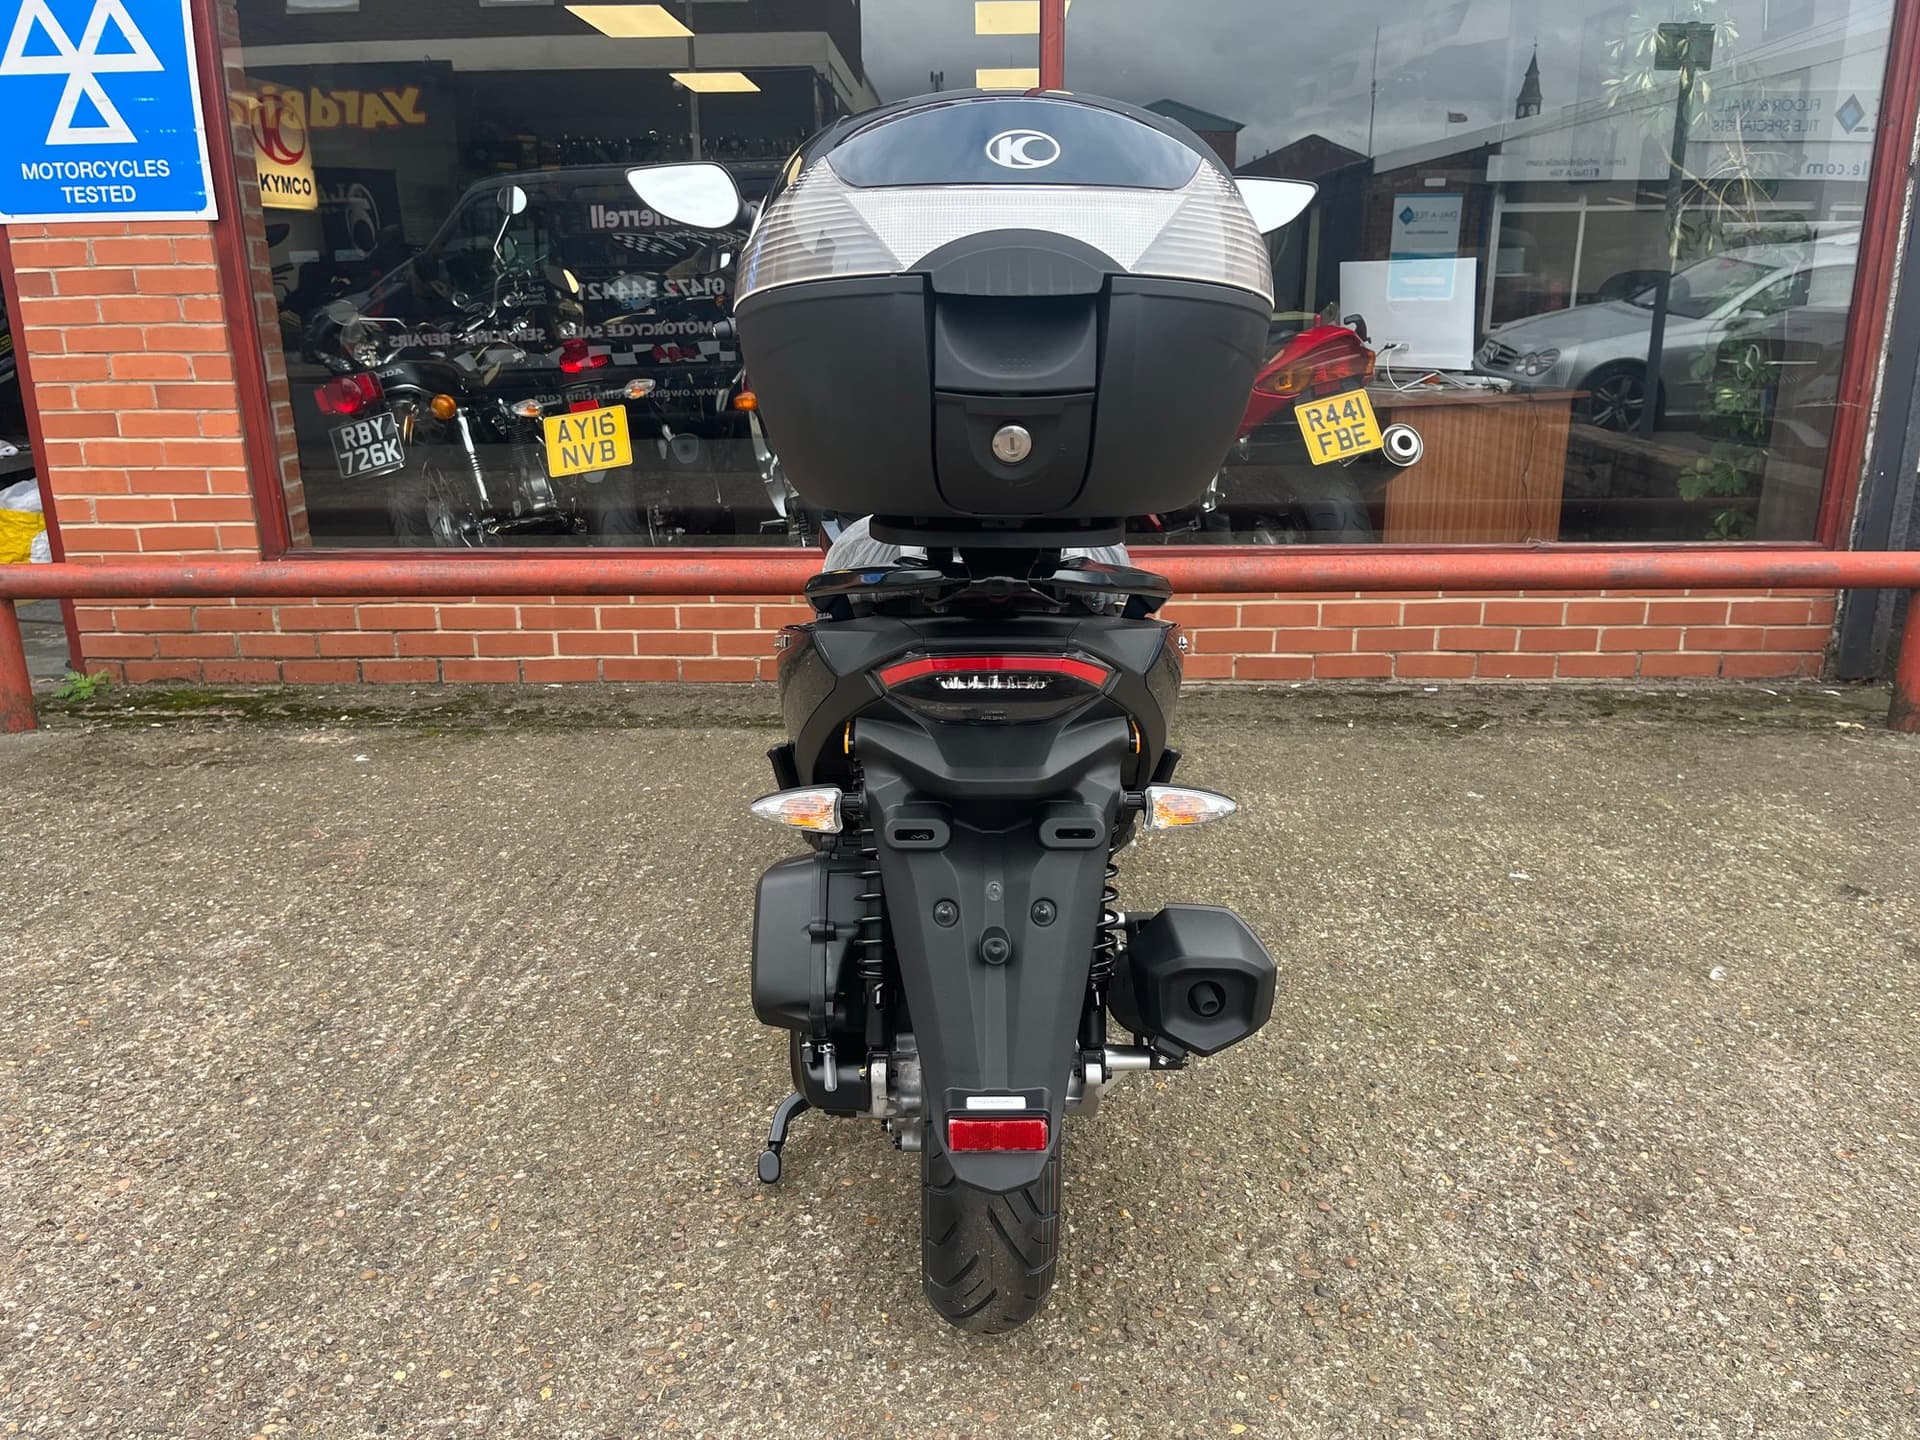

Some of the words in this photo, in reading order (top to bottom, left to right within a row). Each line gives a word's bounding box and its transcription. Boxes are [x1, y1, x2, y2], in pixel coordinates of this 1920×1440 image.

[21, 160, 171, 180] MOTORCYCLES
[259, 173, 312, 195] KYMCO
[61, 185, 136, 203] TESTED
[376, 368, 404, 378] NDA
[557, 413, 616, 443] AY16
[1305, 396, 1366, 432] R441
[342, 416, 385, 450] RBY
[1317, 422, 1371, 456] FBE
[340, 437, 402, 475] 726K
[562, 439, 616, 469] NVB
